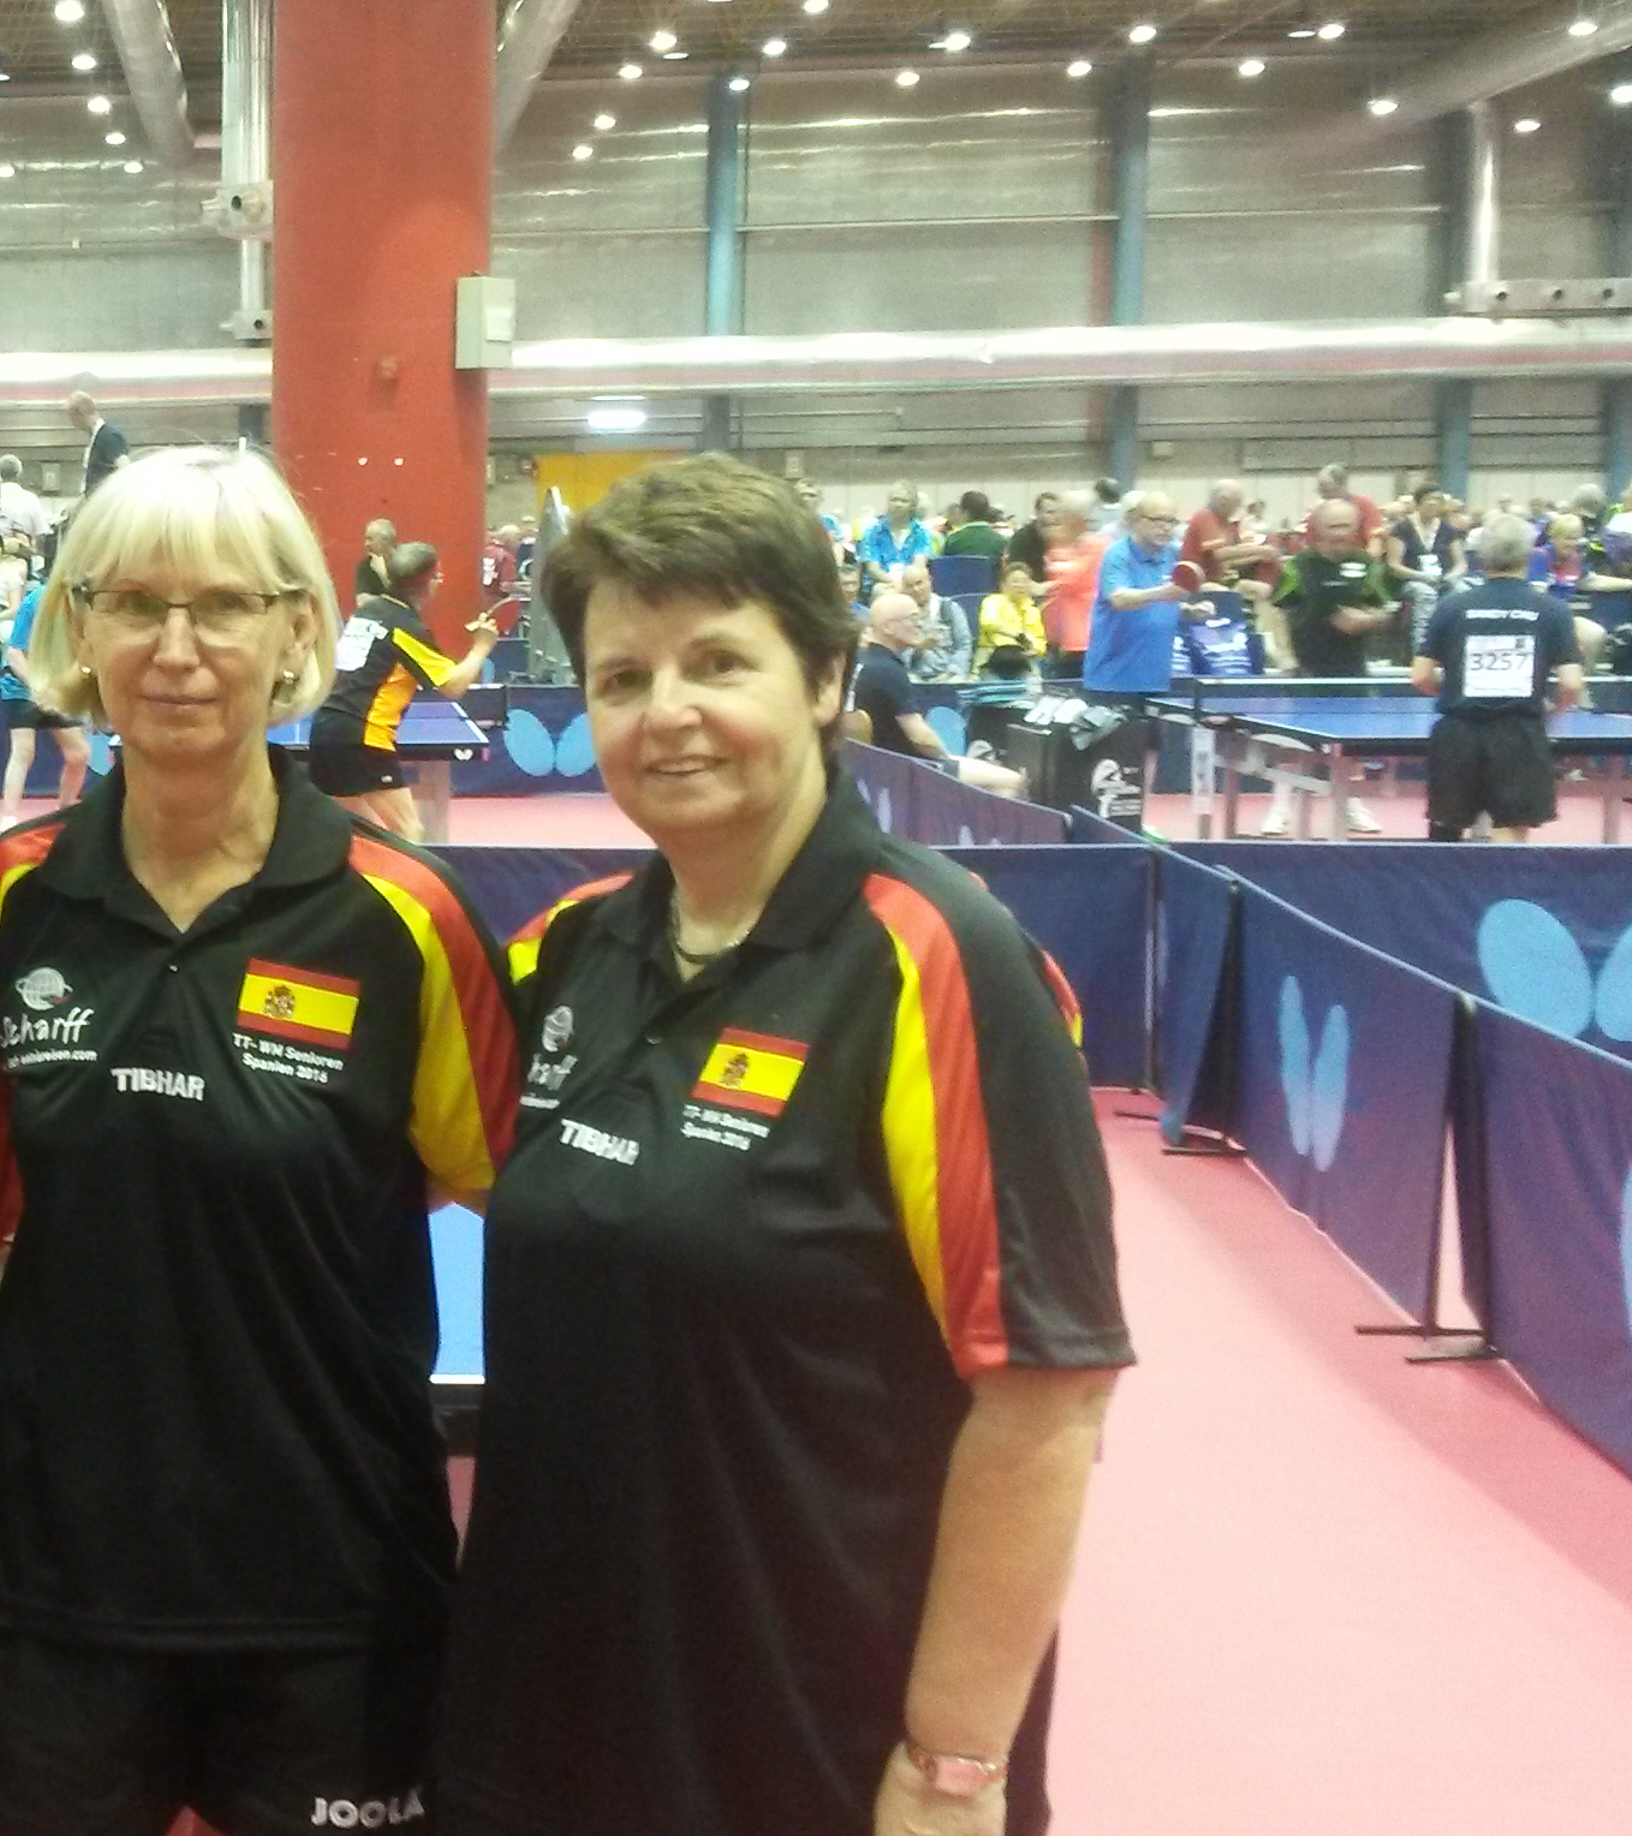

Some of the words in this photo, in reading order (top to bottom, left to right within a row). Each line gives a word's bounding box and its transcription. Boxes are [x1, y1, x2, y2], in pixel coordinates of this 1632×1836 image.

[1469, 652, 1529, 671] 3257
[110, 1067, 206, 1102] TIBHAR
[310, 1788, 426, 1829] JOOLA
